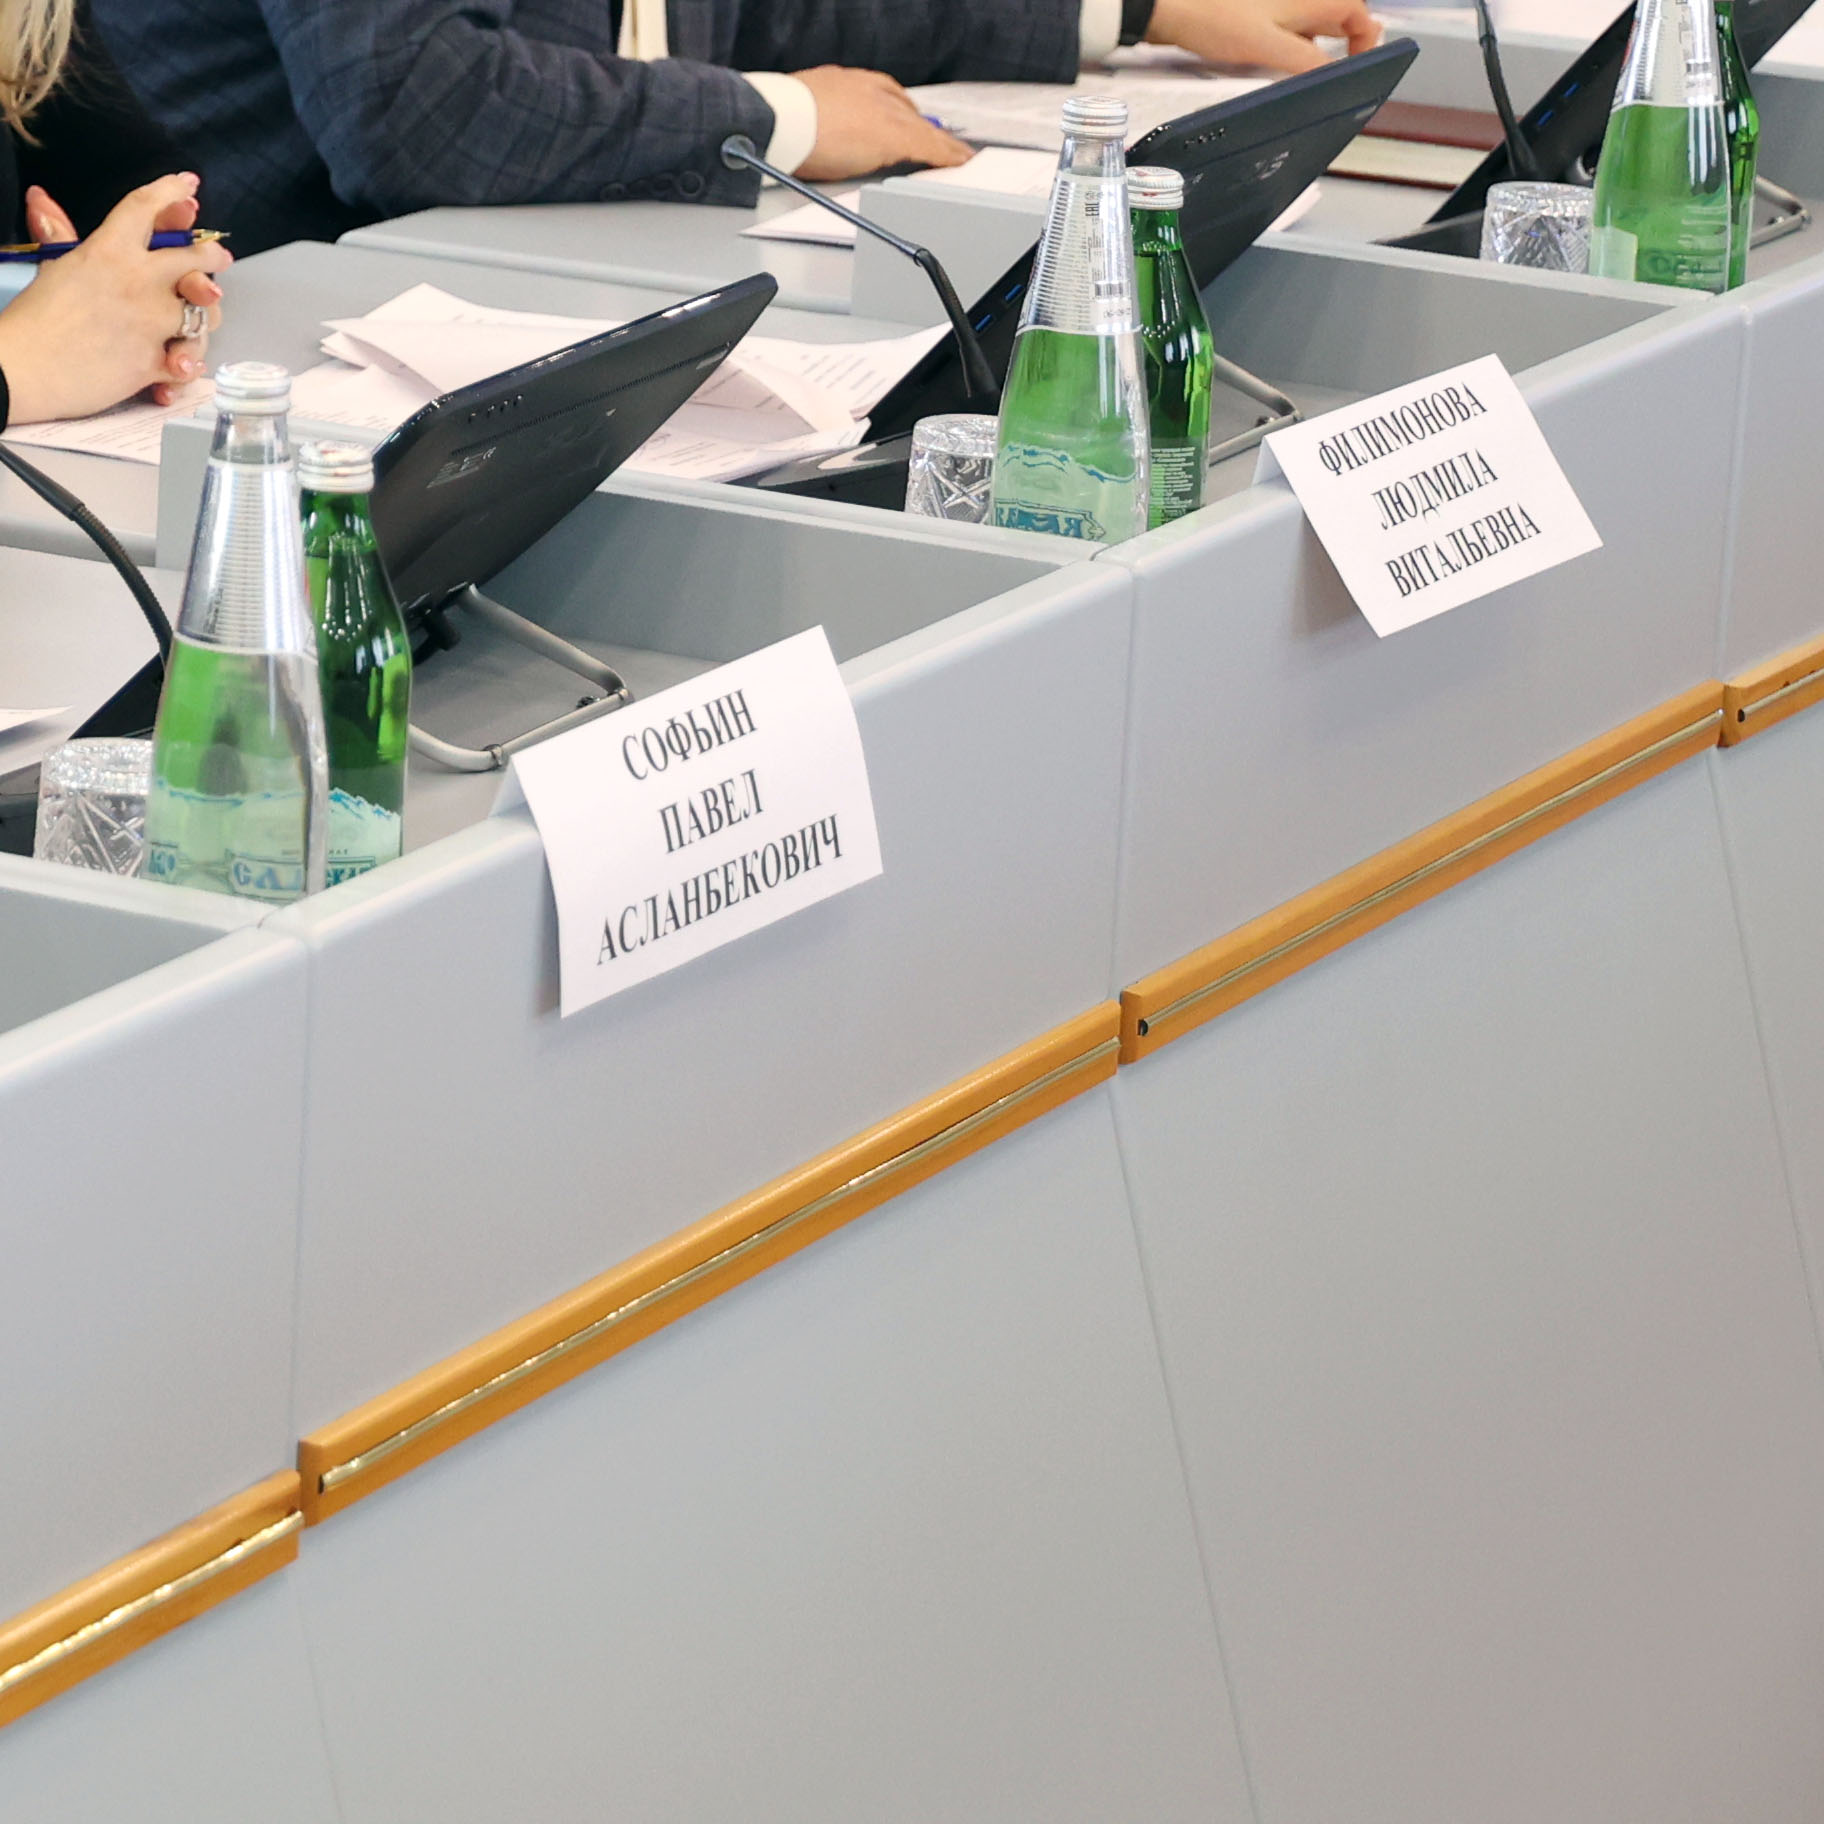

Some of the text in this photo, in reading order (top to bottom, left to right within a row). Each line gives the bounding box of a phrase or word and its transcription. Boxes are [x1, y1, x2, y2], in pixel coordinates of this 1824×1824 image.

[1318, 382, 1488, 477] ФИЛИМОНОВА
[1371, 448, 1499, 530] ЛЮДМИЛА
[1384, 502, 1542, 598] ВИТАЛЬЕВНА
[622, 689, 757, 781] СОФЬИН
[658, 769, 764, 854] ПАВЕЛ
[596, 814, 843, 966] АСЛАНБЕКОВИЧ
